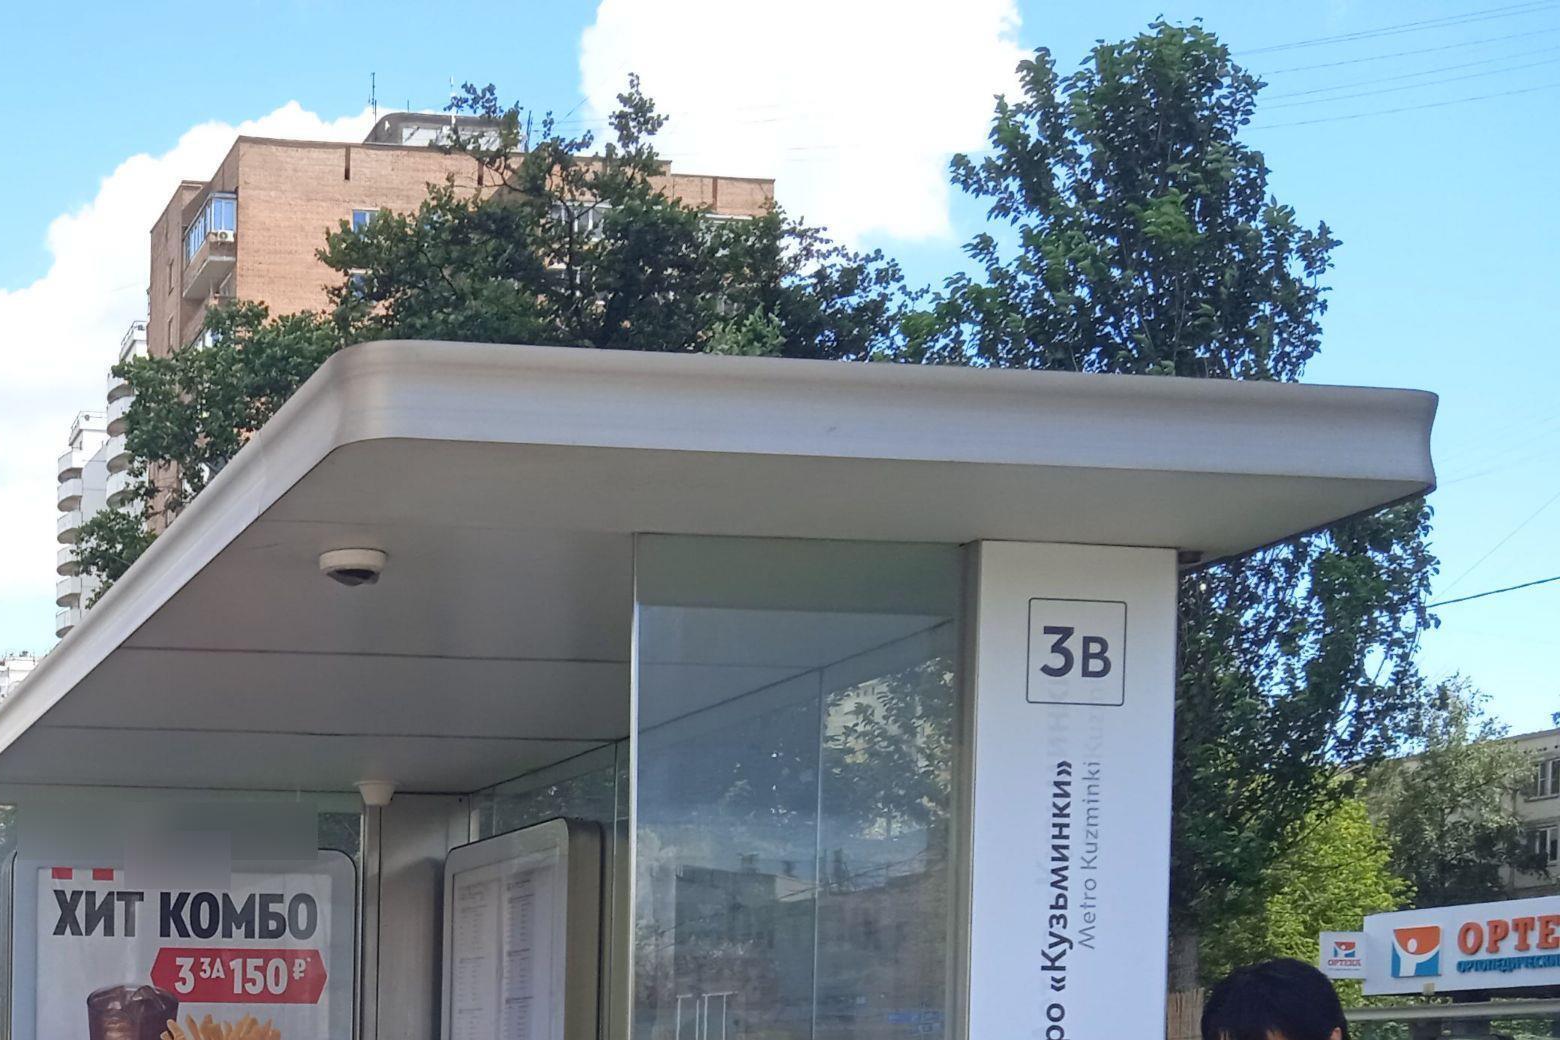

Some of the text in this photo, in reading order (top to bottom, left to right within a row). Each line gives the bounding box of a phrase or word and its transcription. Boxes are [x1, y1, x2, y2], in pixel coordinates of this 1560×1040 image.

[52, 888, 318, 940] ХИТ КОМБО
[1040, 759, 1074, 993] «Кузьминки»
[1077, 760, 1102, 951] Metro Kuzminki
